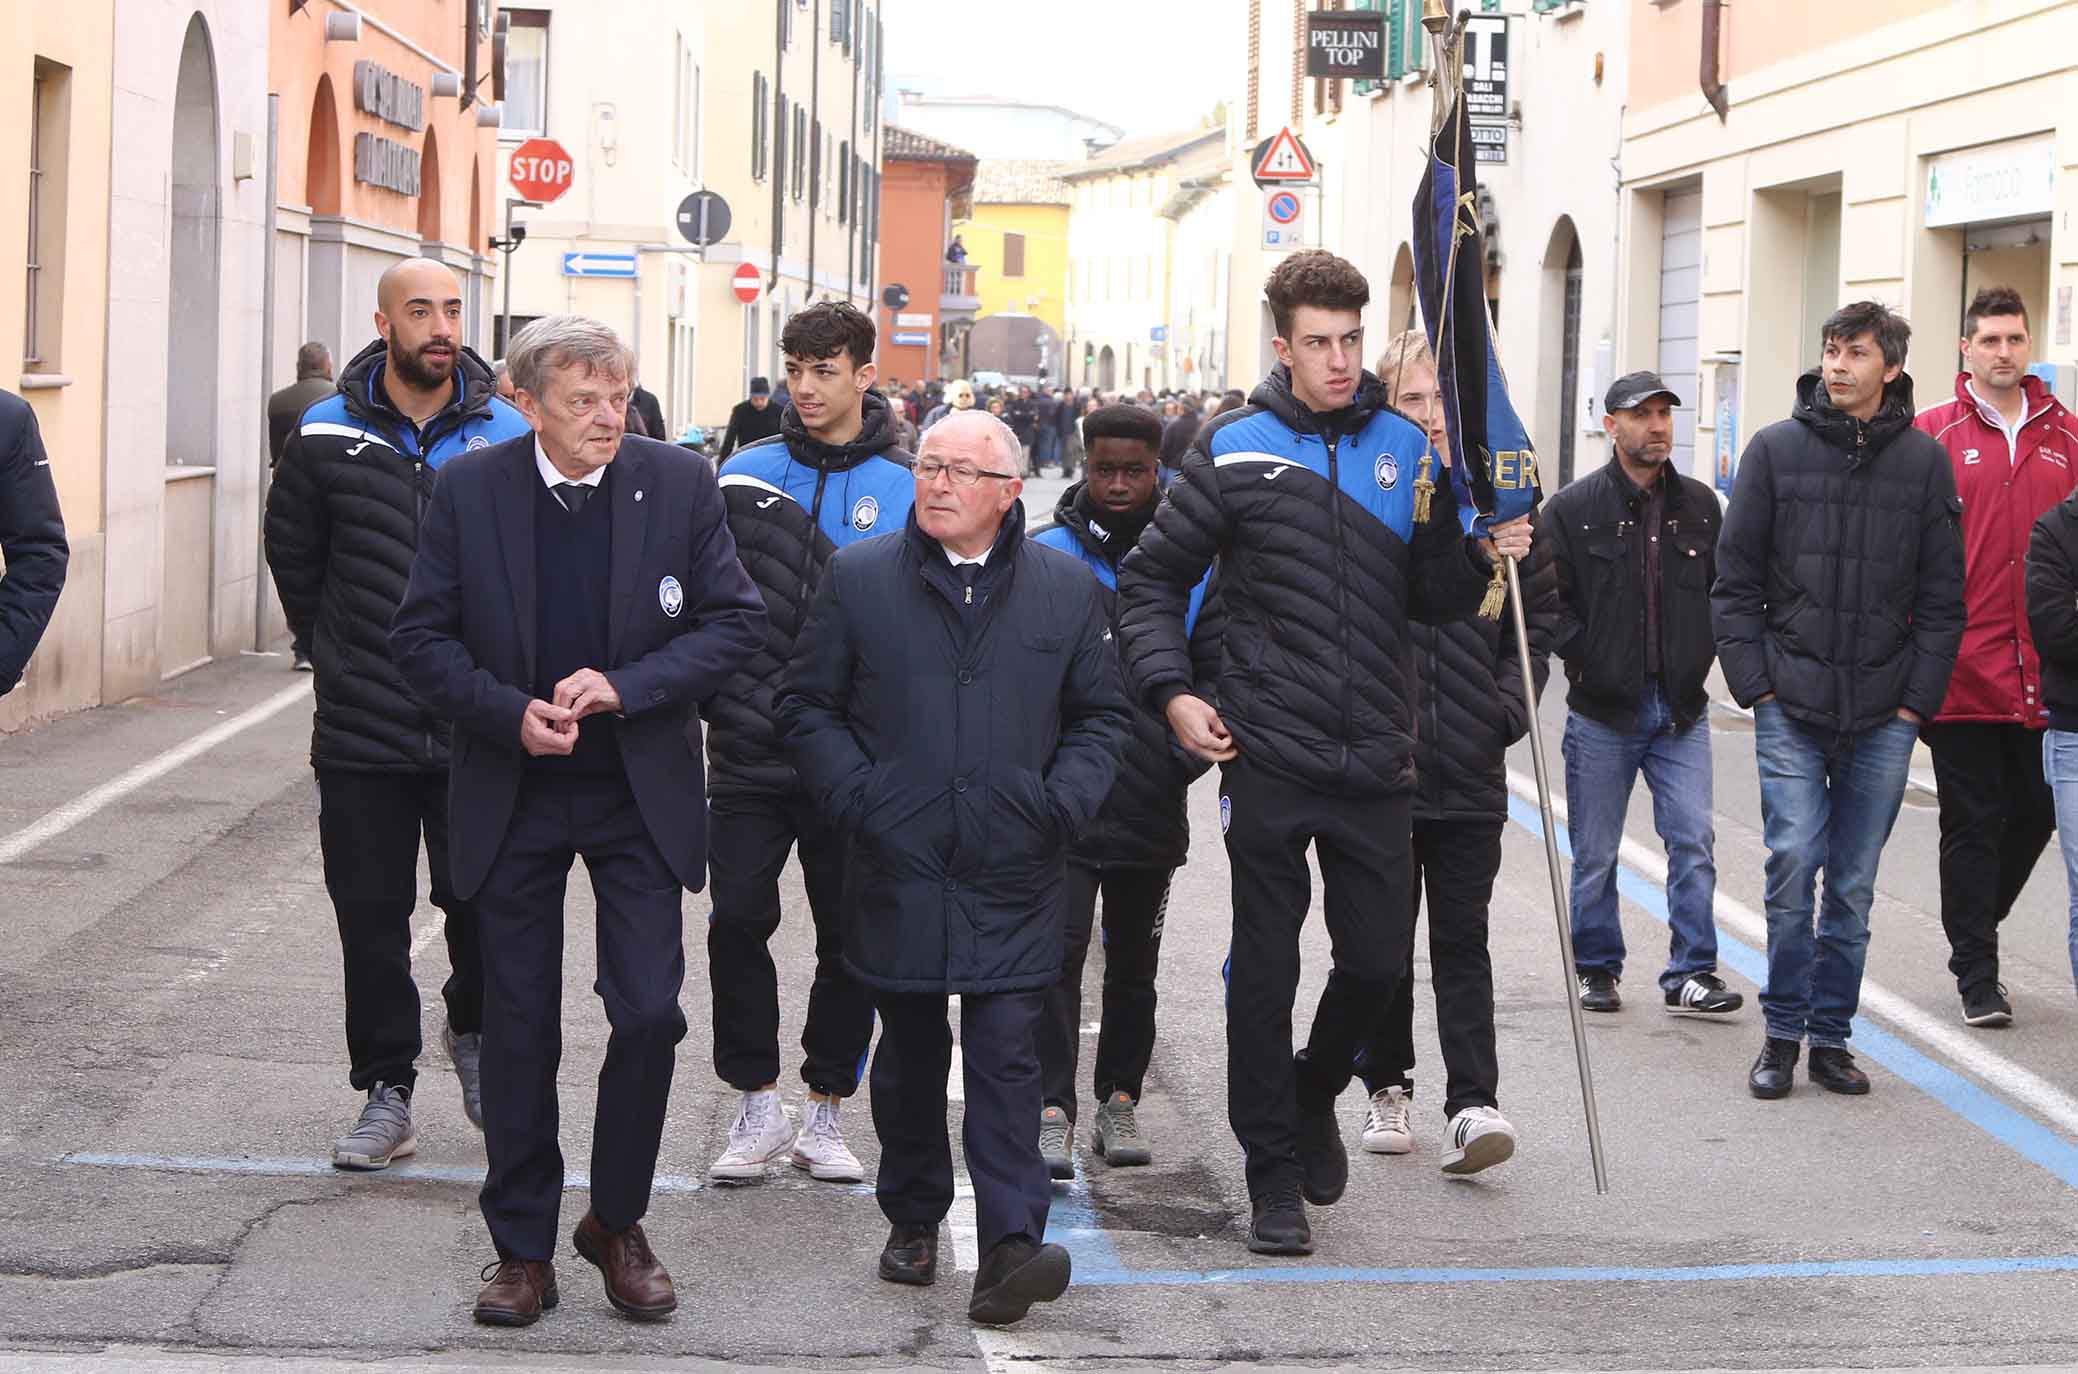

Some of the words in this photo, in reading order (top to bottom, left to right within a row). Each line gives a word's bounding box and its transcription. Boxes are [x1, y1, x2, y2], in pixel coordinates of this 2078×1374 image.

[1311, 30, 1378, 48] PELLINI
[1325, 48, 1364, 66] TOP
[1466, 94, 1503, 105] ABACCHI
[1471, 129, 1502, 141] OTTO
[512, 158, 571, 184] STOP
